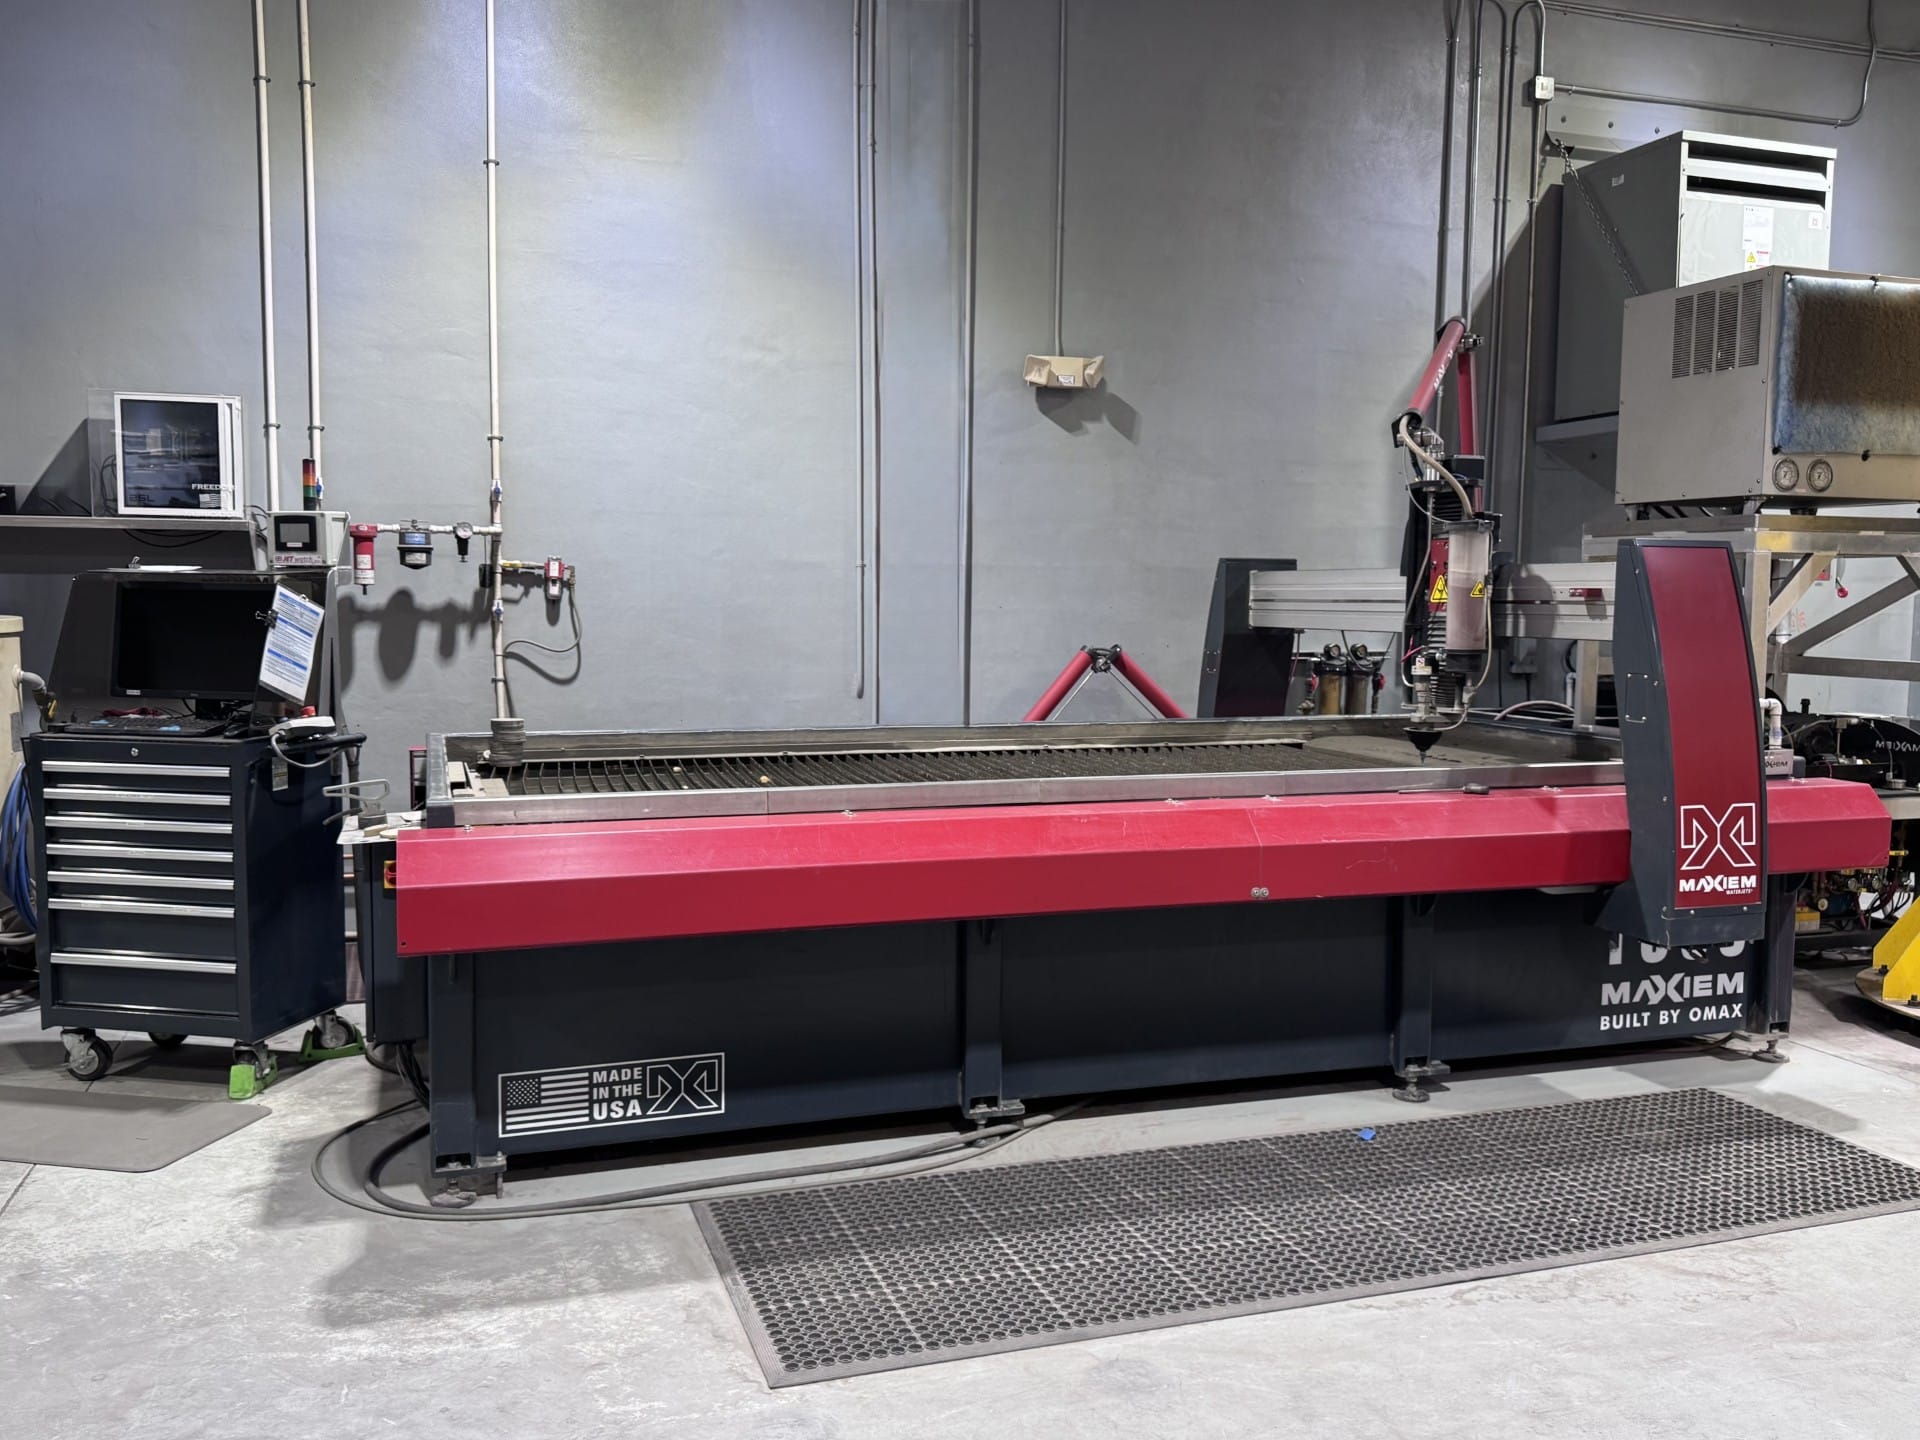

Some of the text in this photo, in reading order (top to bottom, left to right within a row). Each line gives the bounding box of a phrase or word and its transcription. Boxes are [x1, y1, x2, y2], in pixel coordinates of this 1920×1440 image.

[191, 483, 235, 491] FREED
[1679, 874, 1757, 893] MAXIEM
[1601, 972, 1745, 1006] MAXIEM
[1600, 1003, 1743, 1031] BUILT BY OMAX
[593, 1067, 643, 1084] MADE
[593, 1083, 643, 1100] IN THE
[593, 1099, 643, 1121] USA
